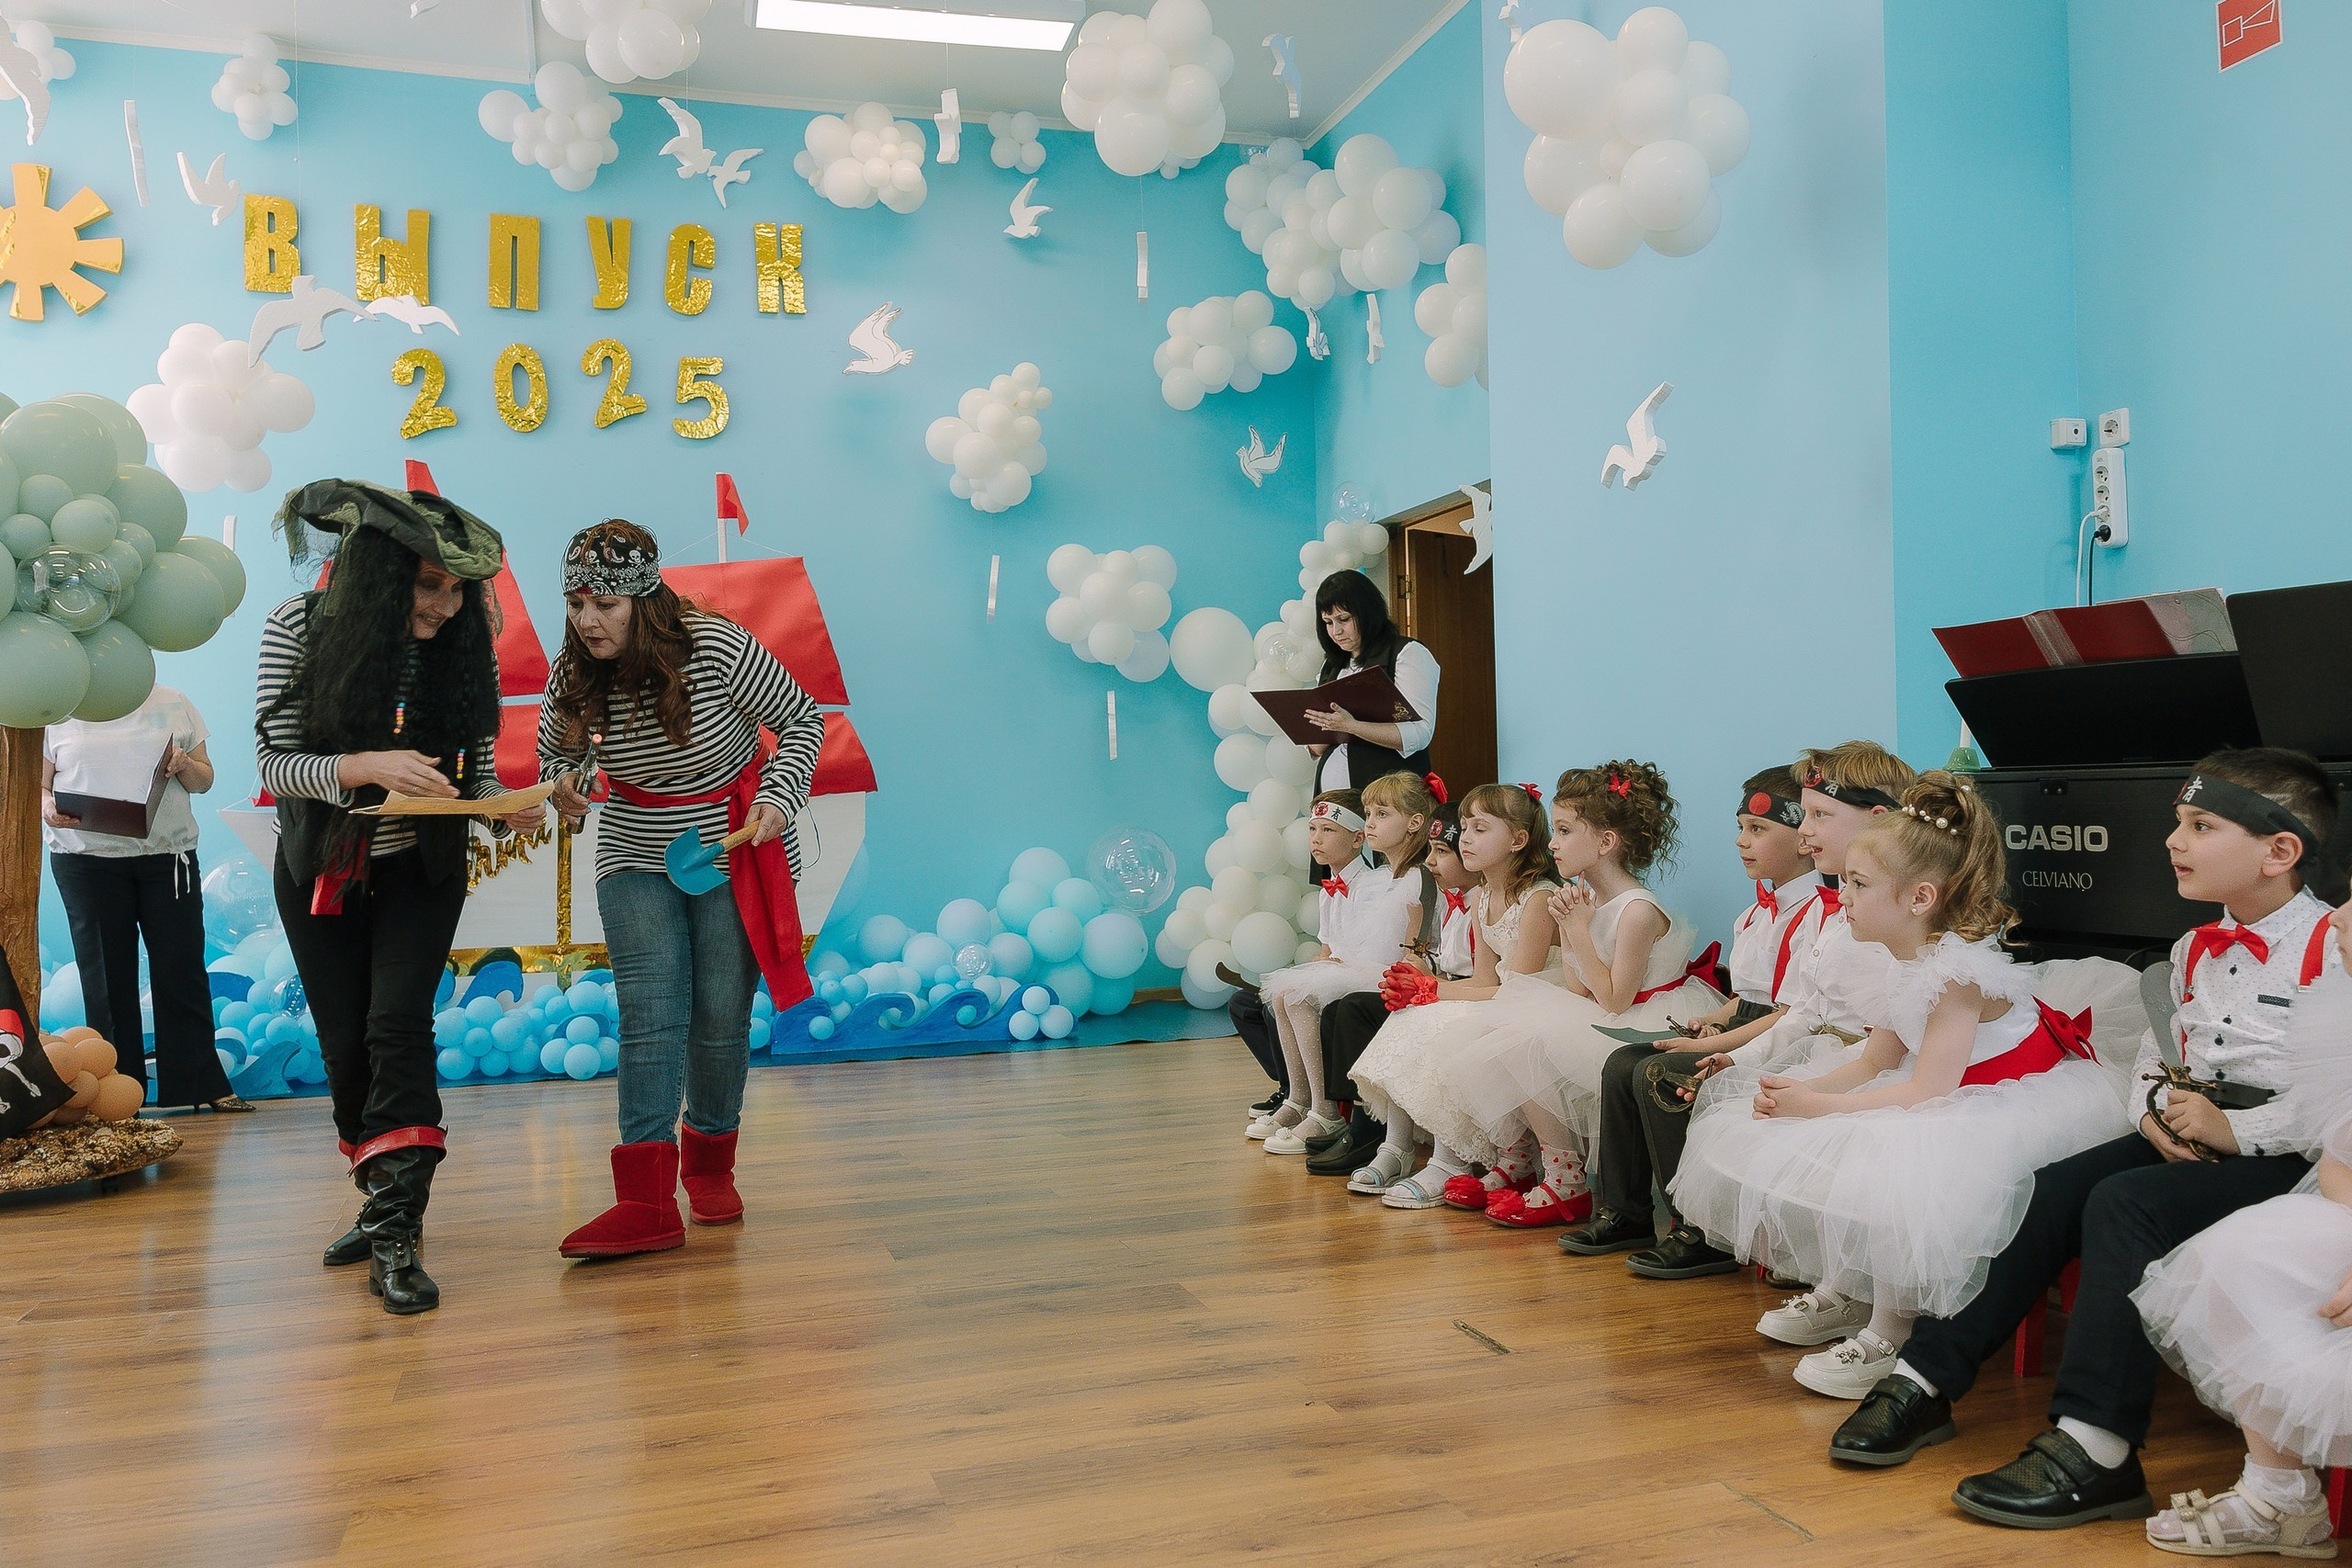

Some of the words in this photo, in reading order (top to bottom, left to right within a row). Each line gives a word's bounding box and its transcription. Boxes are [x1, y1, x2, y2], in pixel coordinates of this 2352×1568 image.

[243, 194, 807, 315] ВЫПУСК
[390, 339, 730, 440] 2025
[2005, 825, 2109, 852] CASIO
[2022, 870, 2093, 892] CELVIANO
